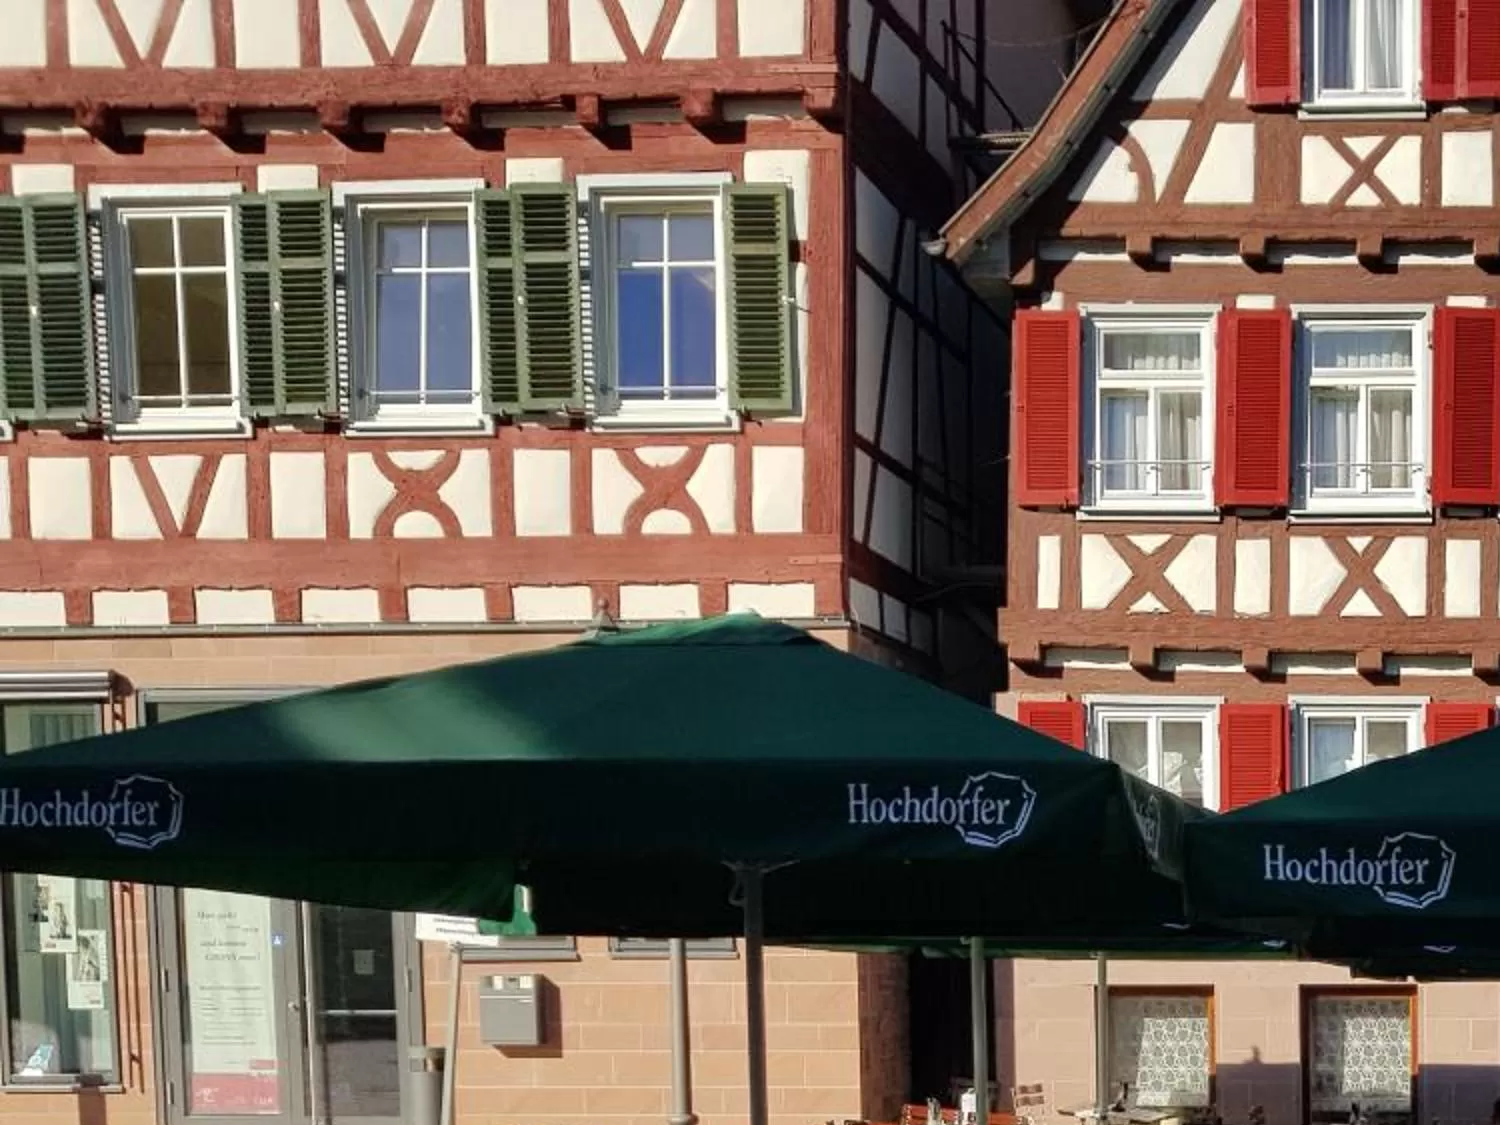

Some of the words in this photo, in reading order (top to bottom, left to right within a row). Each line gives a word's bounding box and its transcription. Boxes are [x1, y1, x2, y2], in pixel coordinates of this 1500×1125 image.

[0, 787, 160, 827] Hochdorfer
[847, 783, 1011, 825] Hochdorfer
[1263, 844, 1430, 885] Hochdorfer
